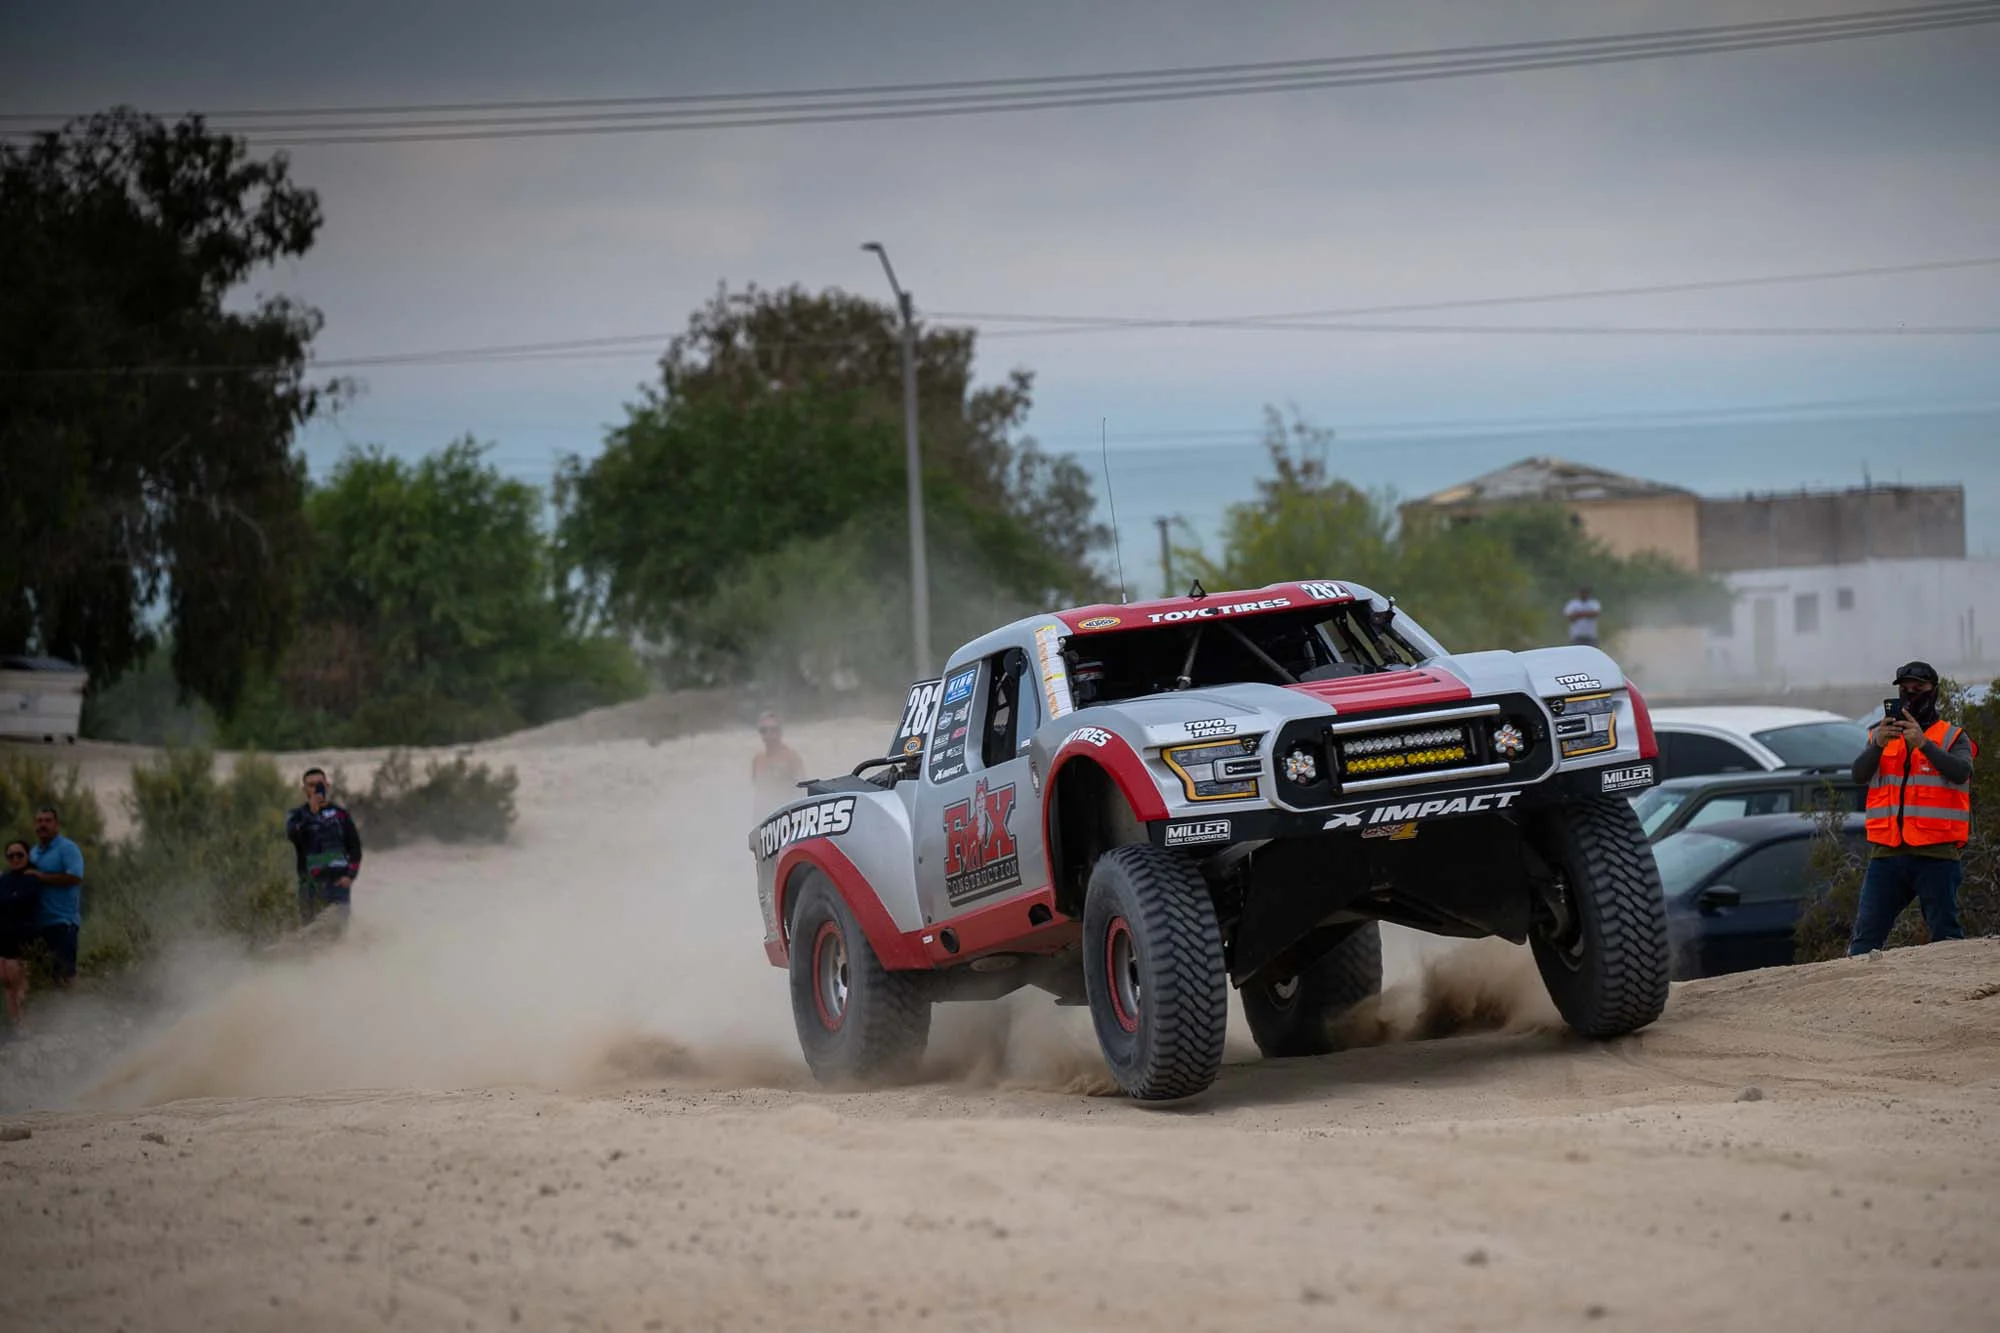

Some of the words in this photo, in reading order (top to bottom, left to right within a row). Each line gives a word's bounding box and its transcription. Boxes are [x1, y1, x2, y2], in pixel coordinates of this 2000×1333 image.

[1301, 583, 1348, 599] 282
[1218, 599, 1291, 615] TIRES
[1557, 674, 1589, 684] TOYO
[1567, 681, 1600, 691] TIRES
[1185, 719, 1225, 731] TOYO
[1193, 726, 1235, 738] TIRES
[1604, 768, 1651, 784] MILLER
[1368, 790, 1522, 824] IMPACT
[760, 815, 790, 858] TOYO
[790, 799, 854, 841] TIRES
[1168, 822, 1228, 838] MILLER
[946, 860, 1018, 896] CONSTRUCTION
